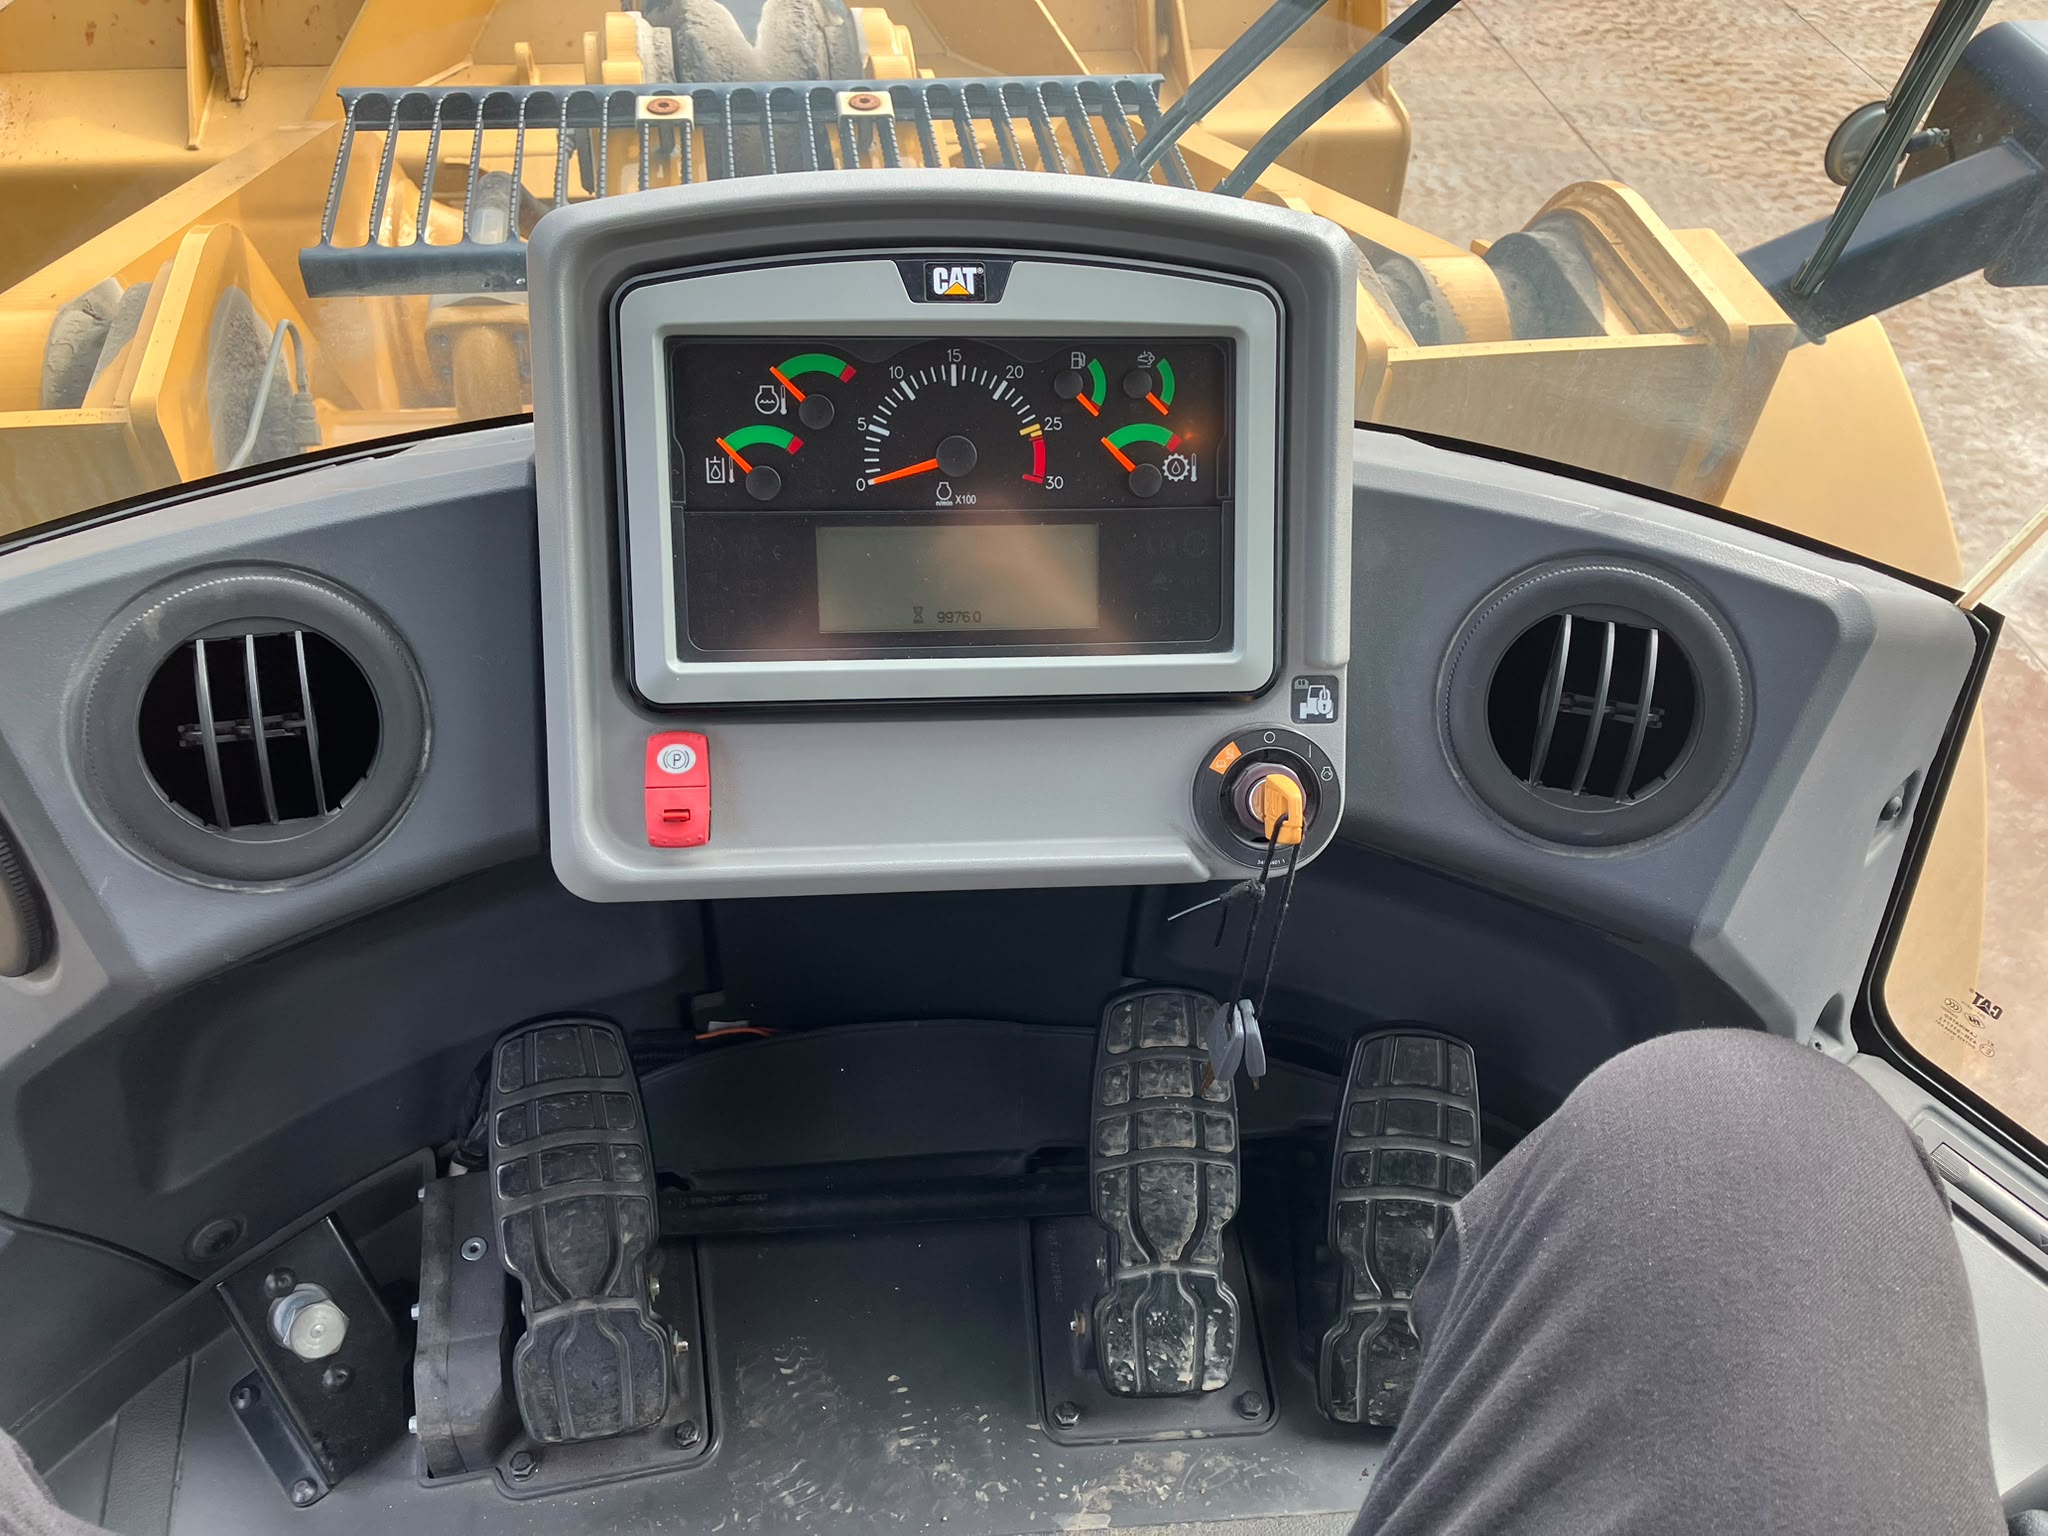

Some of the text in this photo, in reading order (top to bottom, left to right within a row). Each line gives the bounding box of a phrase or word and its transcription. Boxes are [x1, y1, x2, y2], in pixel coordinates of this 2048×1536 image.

[932, 266, 977, 295] CAT
[946, 348, 963, 363] 15
[889, 365, 904, 380] 10
[1005, 365, 1024, 379] 20
[857, 416, 867, 431] 5
[1044, 417, 1063, 431] 25
[856, 478, 866, 491] 0
[1045, 476, 1064, 490] 30
[955, 494, 977, 505] X100
[673, 753, 682, 766] P
